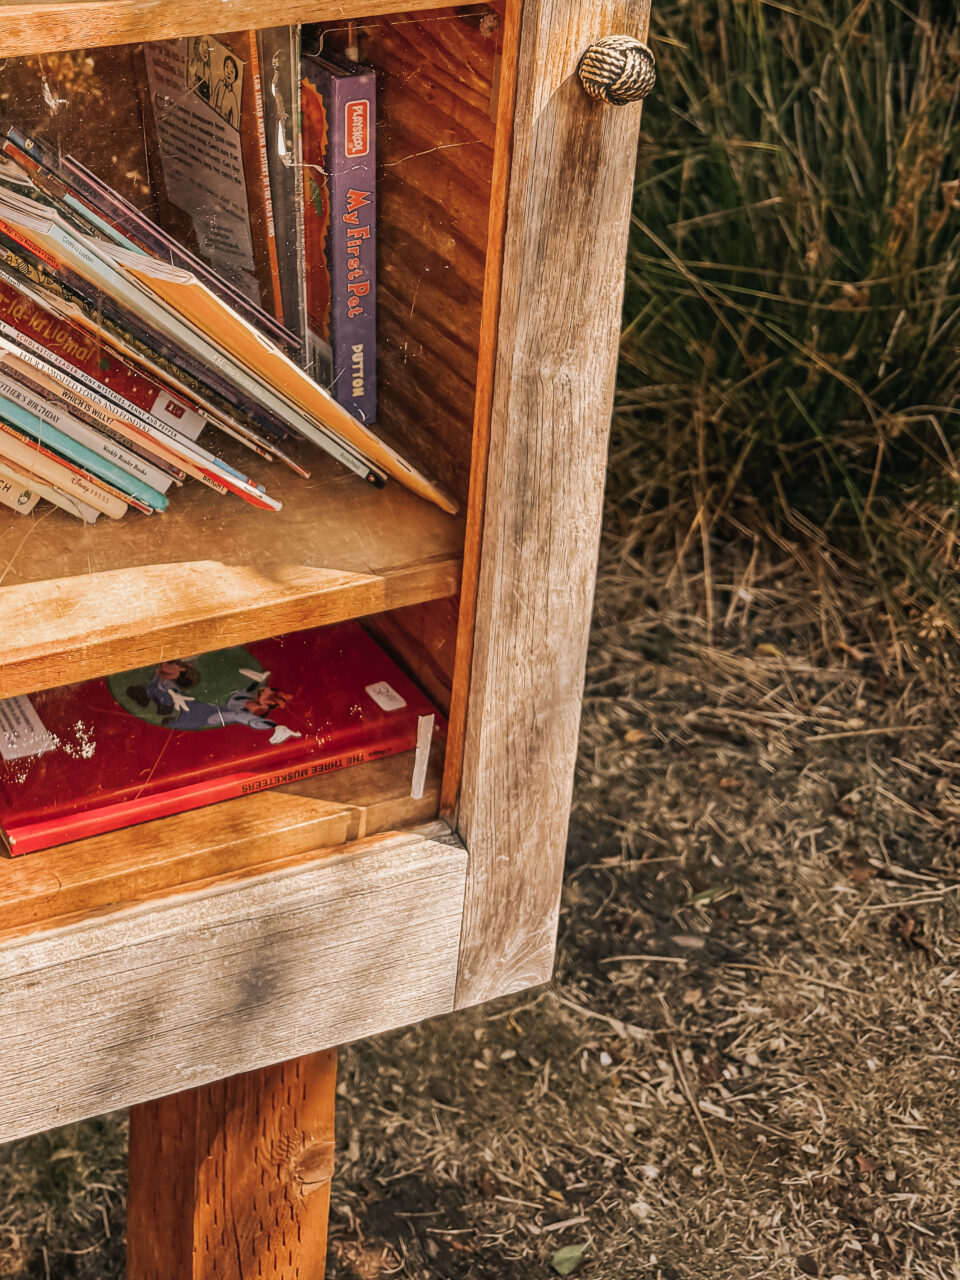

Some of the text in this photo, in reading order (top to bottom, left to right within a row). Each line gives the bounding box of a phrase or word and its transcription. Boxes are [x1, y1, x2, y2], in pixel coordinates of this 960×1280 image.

[350, 104, 363, 153] PLAYSKOOL
[259, 147, 269, 176] MYSTERY
[342, 188, 373, 318] My First Pet
[14, 333, 53, 359] SCHOLASTIC
[350, 343, 364, 397] DUTTON
[61, 389, 113, 426] WHICH WILLY?
[78, 386, 102, 406] FOXES
[26, 399, 60, 424] BIRTHDAY
[101, 443, 118, 459] Weekly
[69, 473, 92, 493] Disney
[309, 757, 343, 775] THREE
[343, 752, 365, 765] THE
[240, 766, 309, 794] MUSKETEERS
